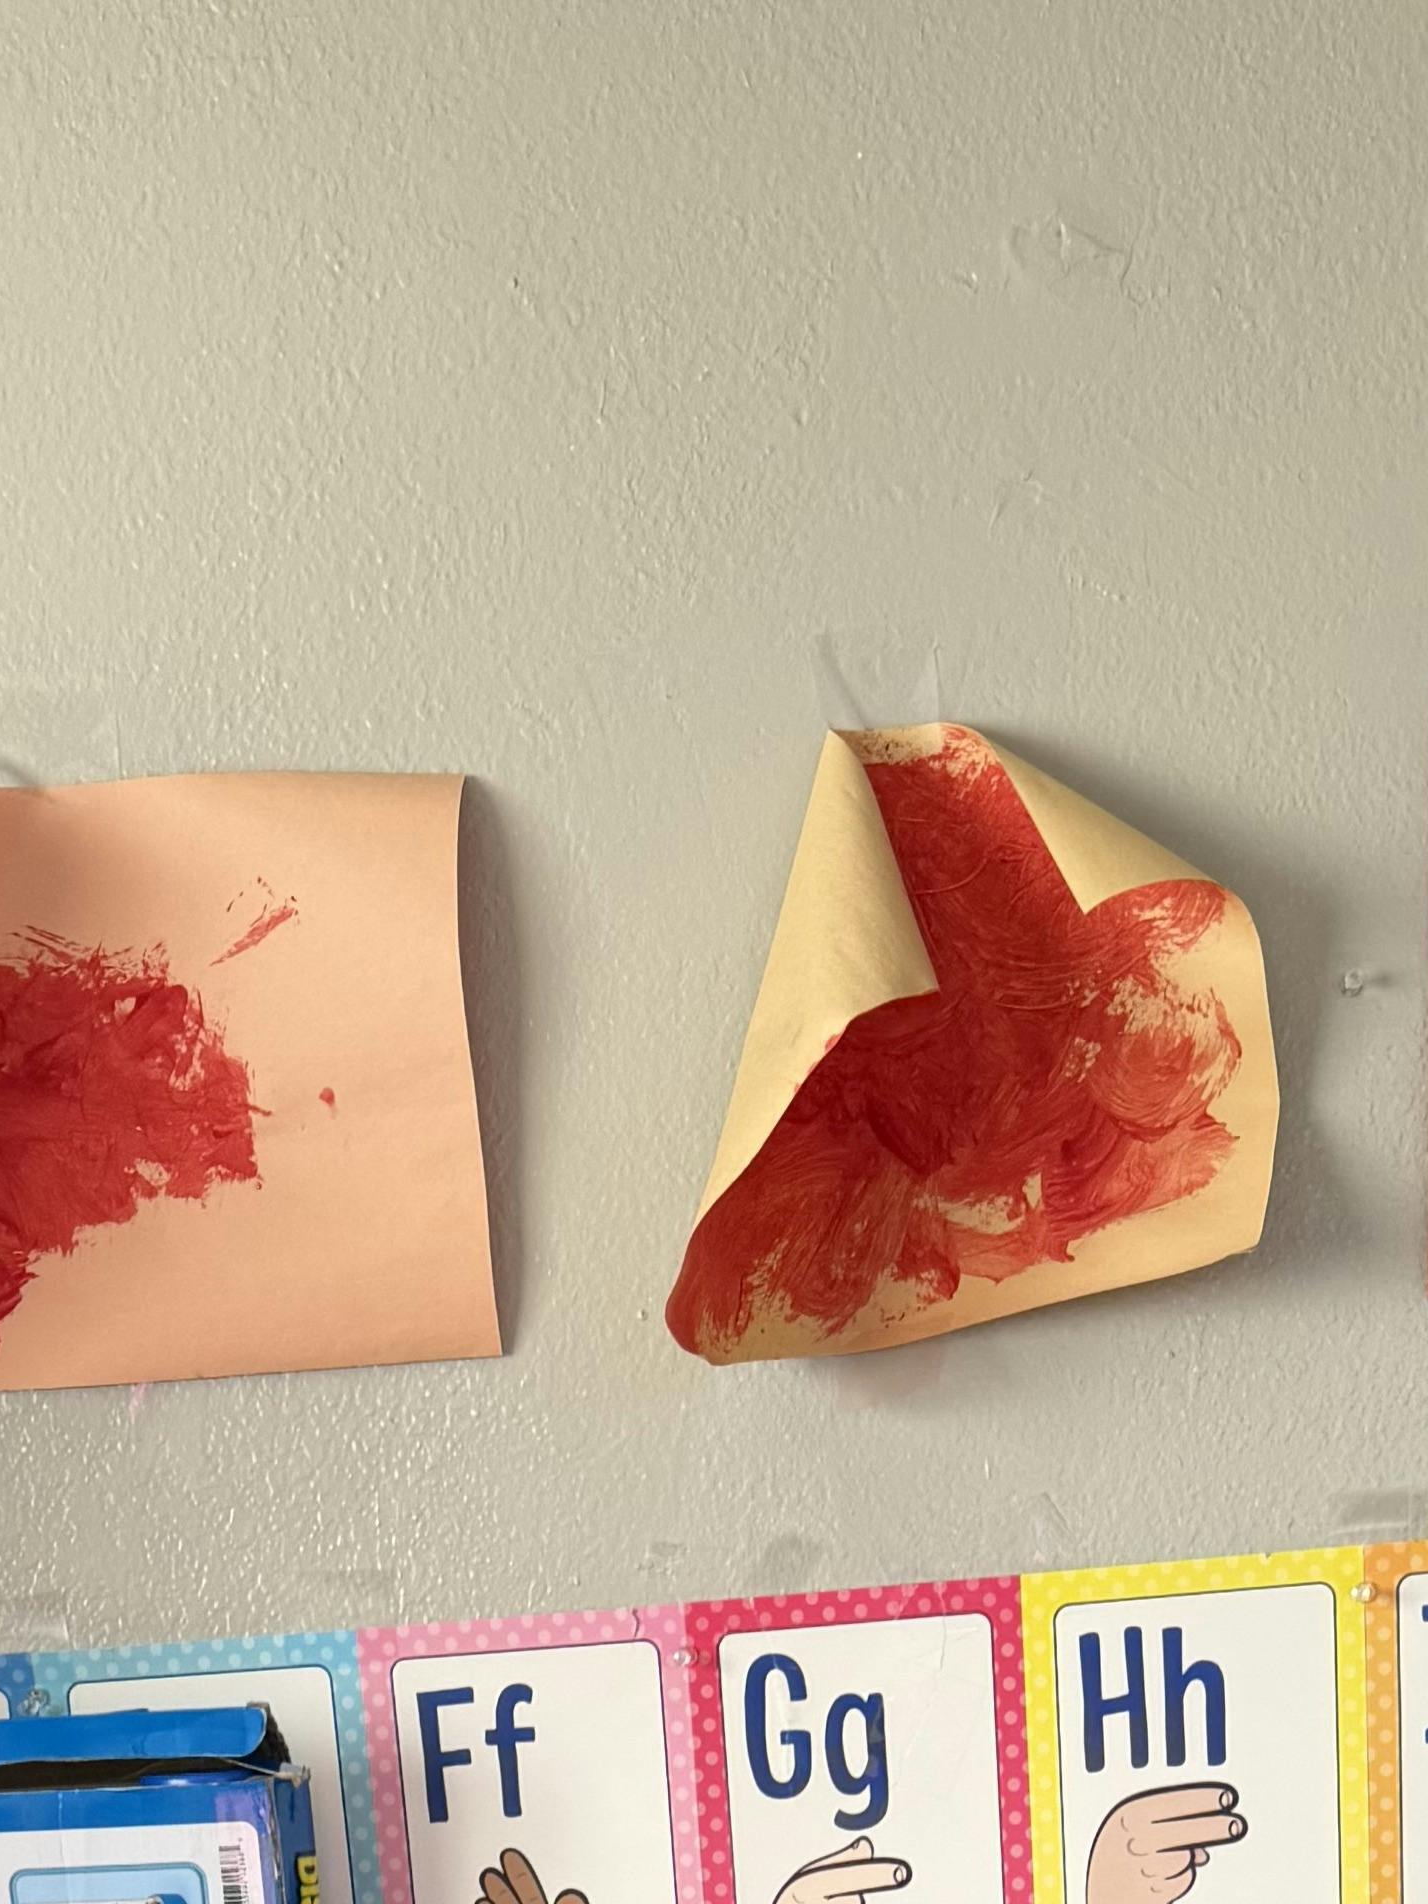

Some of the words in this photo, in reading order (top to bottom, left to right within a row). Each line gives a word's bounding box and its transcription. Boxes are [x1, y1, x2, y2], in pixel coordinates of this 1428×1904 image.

[418, 1685, 535, 1821] Ff
[740, 1653, 892, 1832] Gg
[1078, 1625, 1229, 1773] Hh
